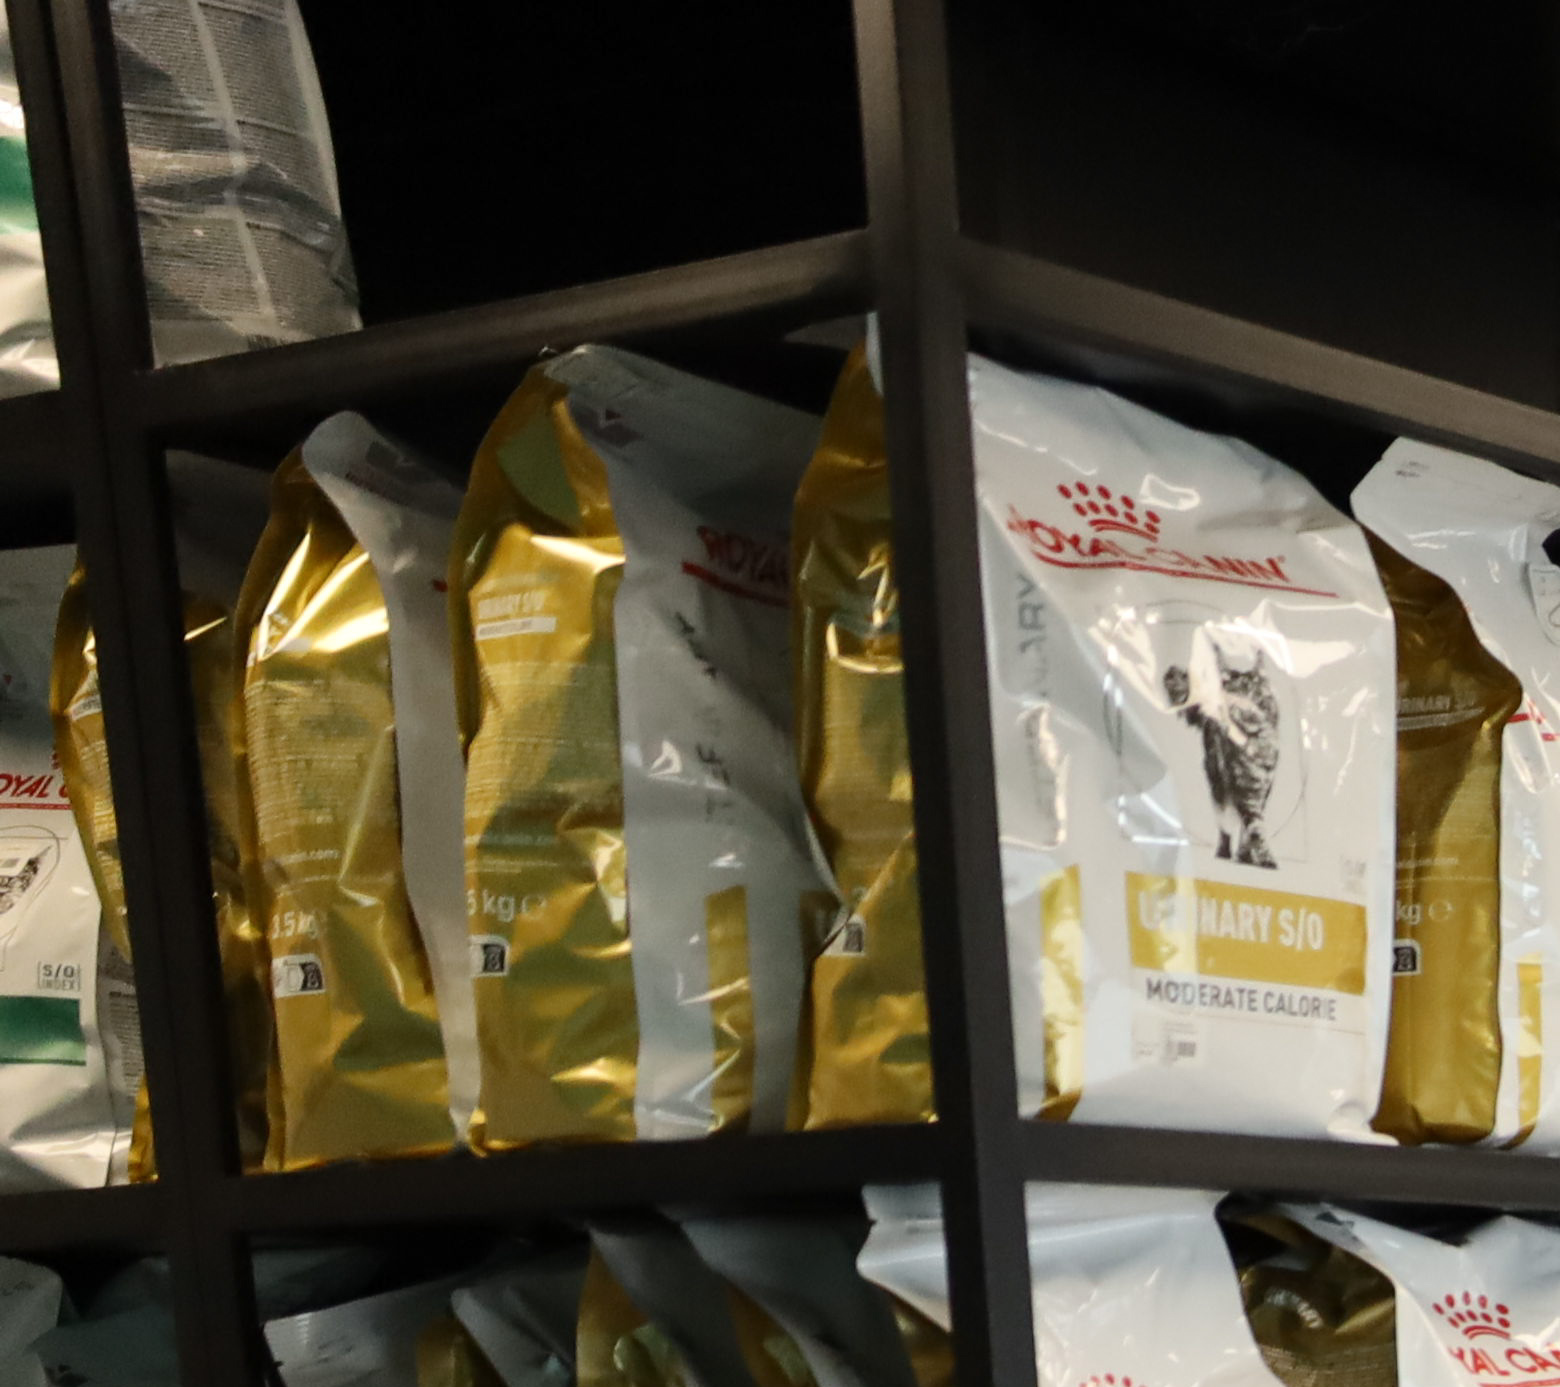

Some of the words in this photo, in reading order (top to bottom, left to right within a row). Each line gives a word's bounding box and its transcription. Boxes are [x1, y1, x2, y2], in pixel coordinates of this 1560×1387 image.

[483, 888, 515, 919] kg
[1278, 909, 1326, 951] S/O
[40, 963, 76, 979] S/O
[1146, 976, 1260, 1013] MODERATE
[1263, 990, 1339, 1022] CALORIE
